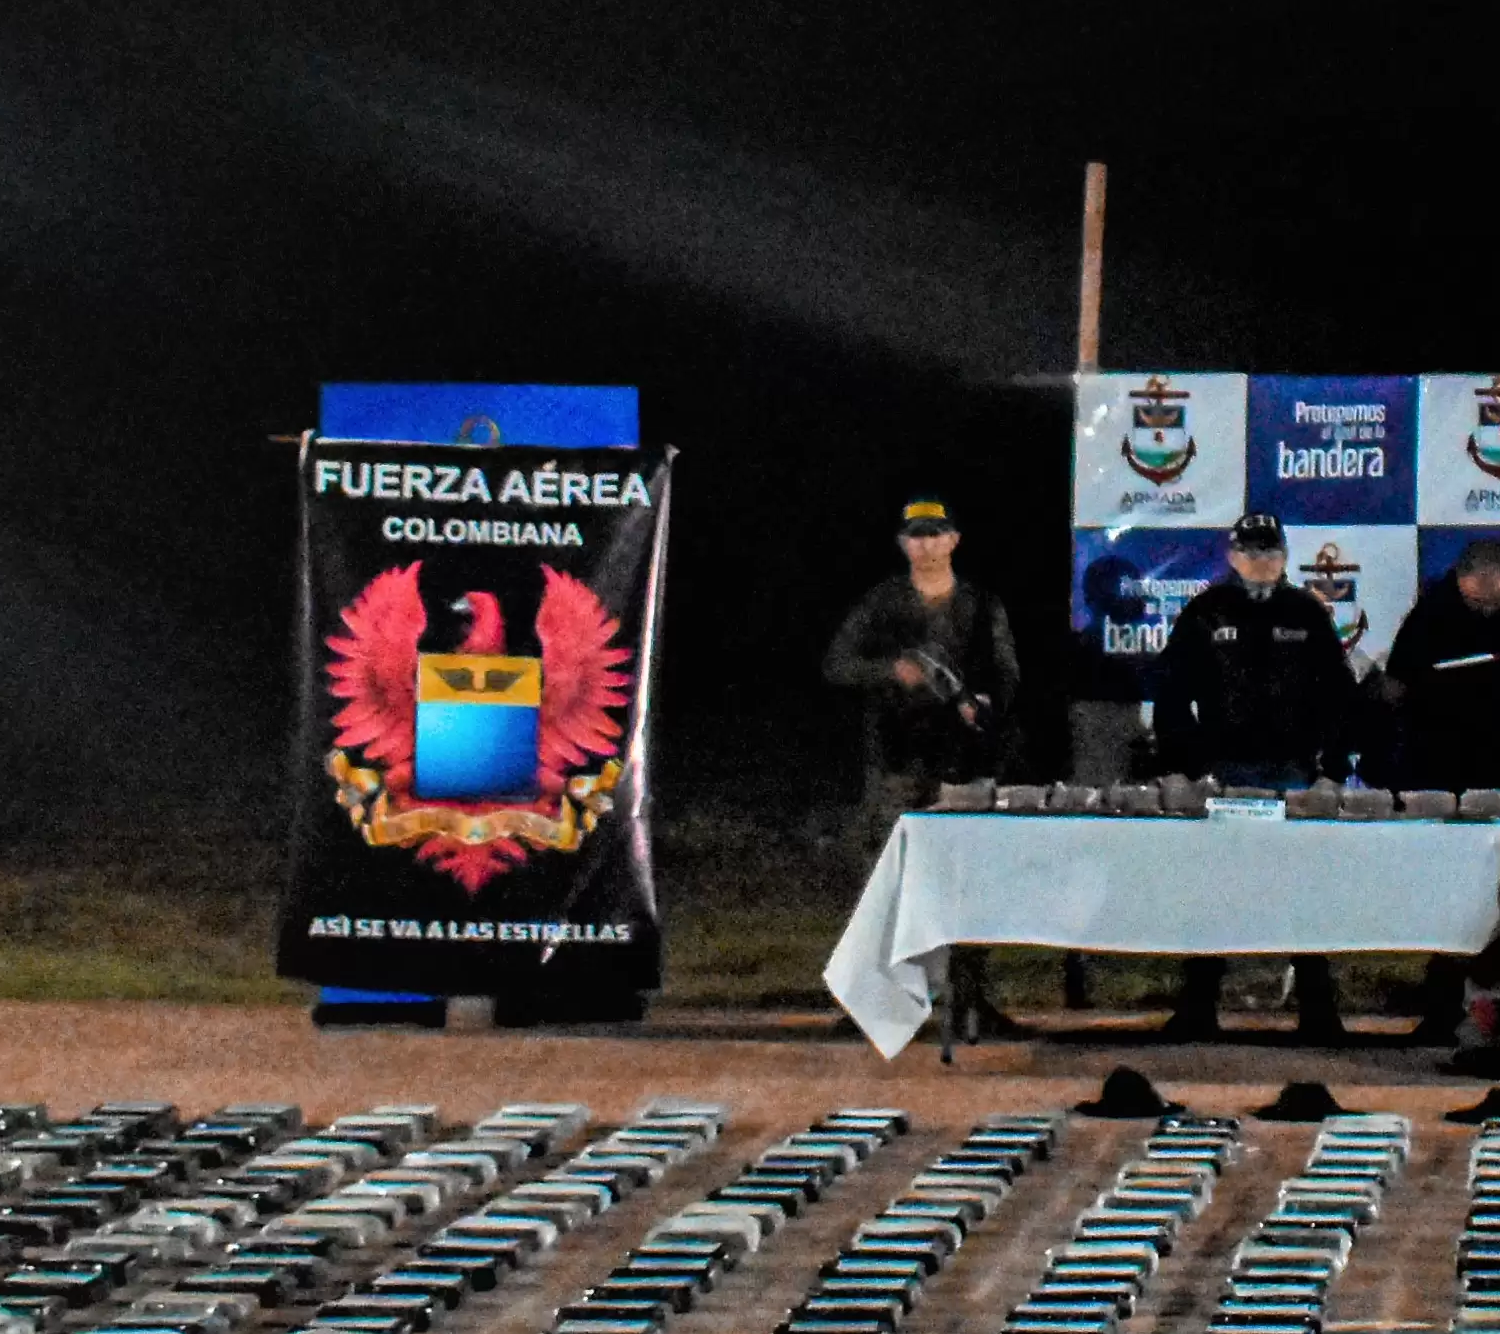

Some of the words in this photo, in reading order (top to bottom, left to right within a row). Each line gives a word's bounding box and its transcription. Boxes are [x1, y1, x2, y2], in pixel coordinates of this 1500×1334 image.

[1278, 440, 1385, 479] bandera
[314, 459, 492, 504] FUERZA
[500, 458, 652, 507] AÉREA
[382, 516, 583, 547] COLOMBIANA
[353, 917, 386, 938] SE
[388, 918, 423, 939] VA
[425, 920, 445, 939] A
[448, 920, 495, 941] LAS
[498, 920, 632, 943] ESTRELLAS
